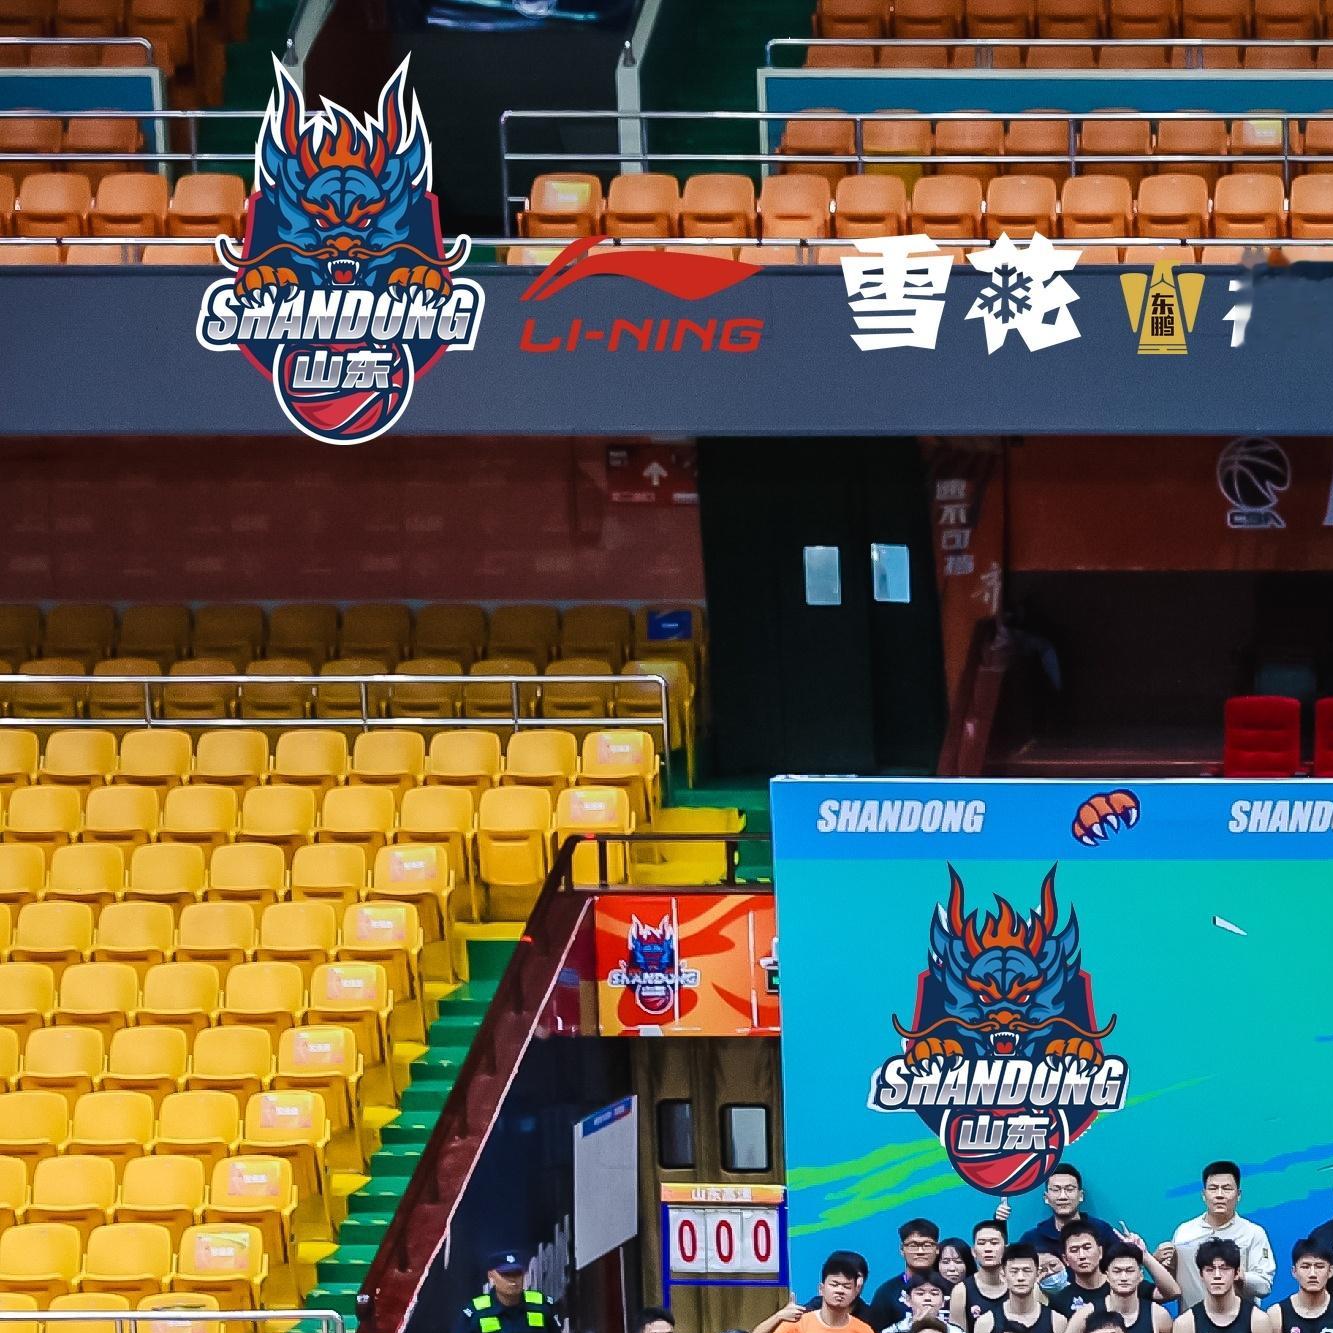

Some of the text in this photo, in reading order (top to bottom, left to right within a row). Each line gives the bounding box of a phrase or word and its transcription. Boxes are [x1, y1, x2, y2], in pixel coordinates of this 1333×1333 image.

[817, 800, 985, 834] SHANDONG
[880, 1058, 1126, 1108] SHANDONG
[959, 1114, 1048, 1151] 山东
